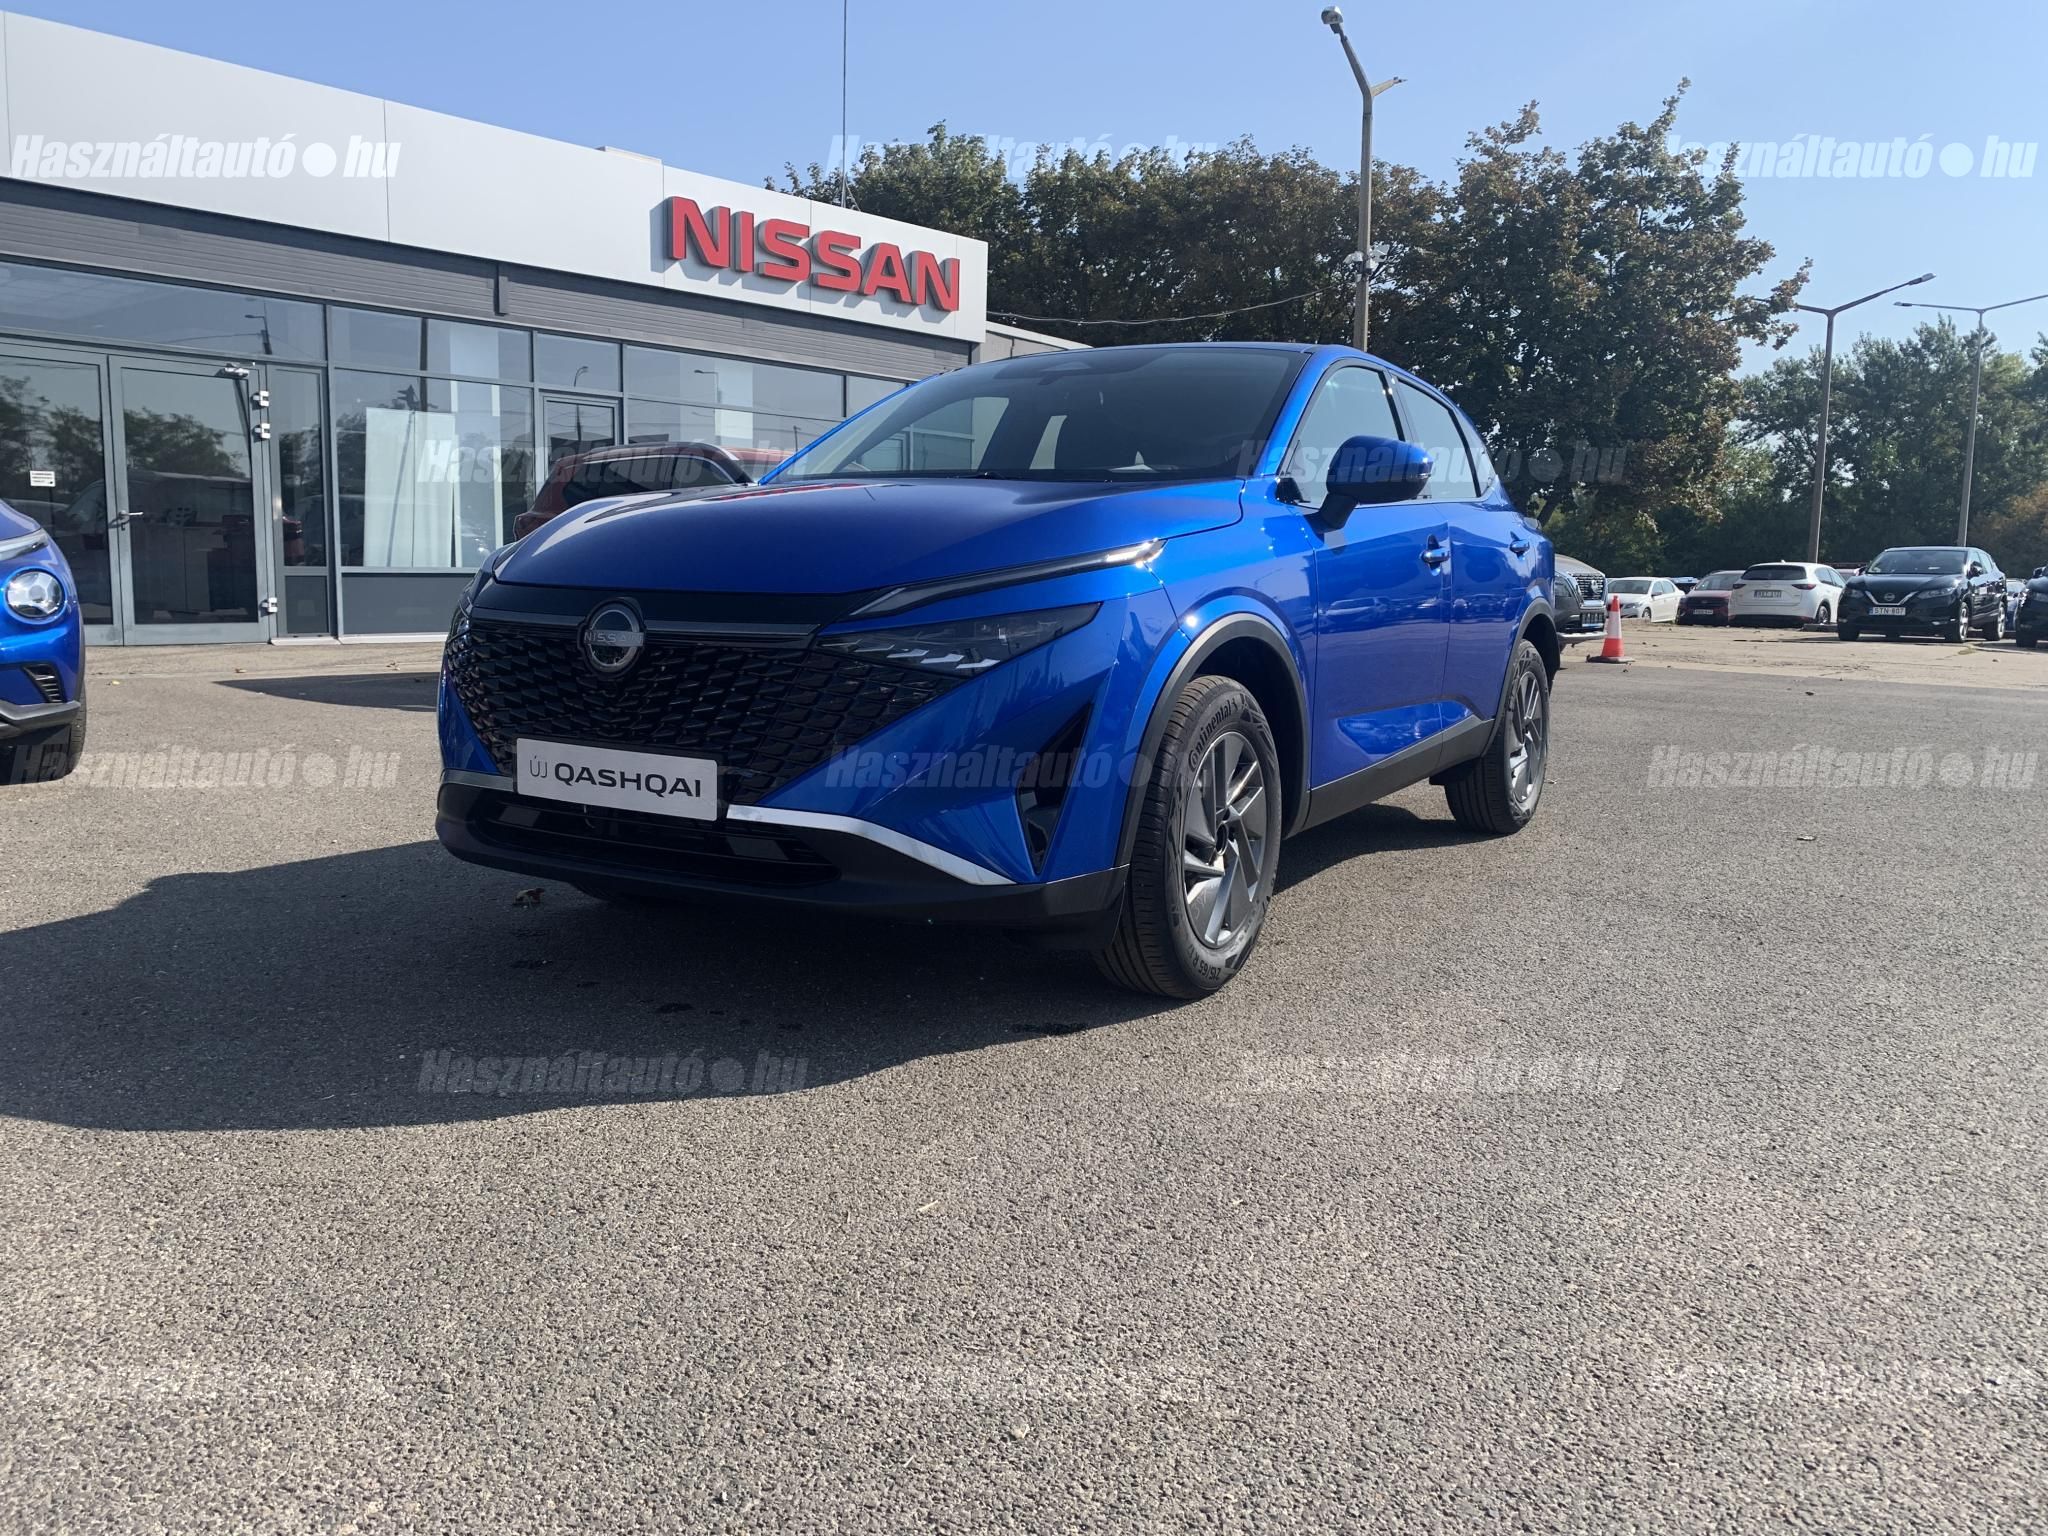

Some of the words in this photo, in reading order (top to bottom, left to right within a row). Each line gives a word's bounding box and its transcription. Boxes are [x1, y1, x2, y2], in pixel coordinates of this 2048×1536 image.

[667, 195, 961, 312] NISSAN
[1188, 699, 1232, 773] Continental
[529, 755, 548, 778] ÚJ
[554, 762, 701, 798] QASHQAI
